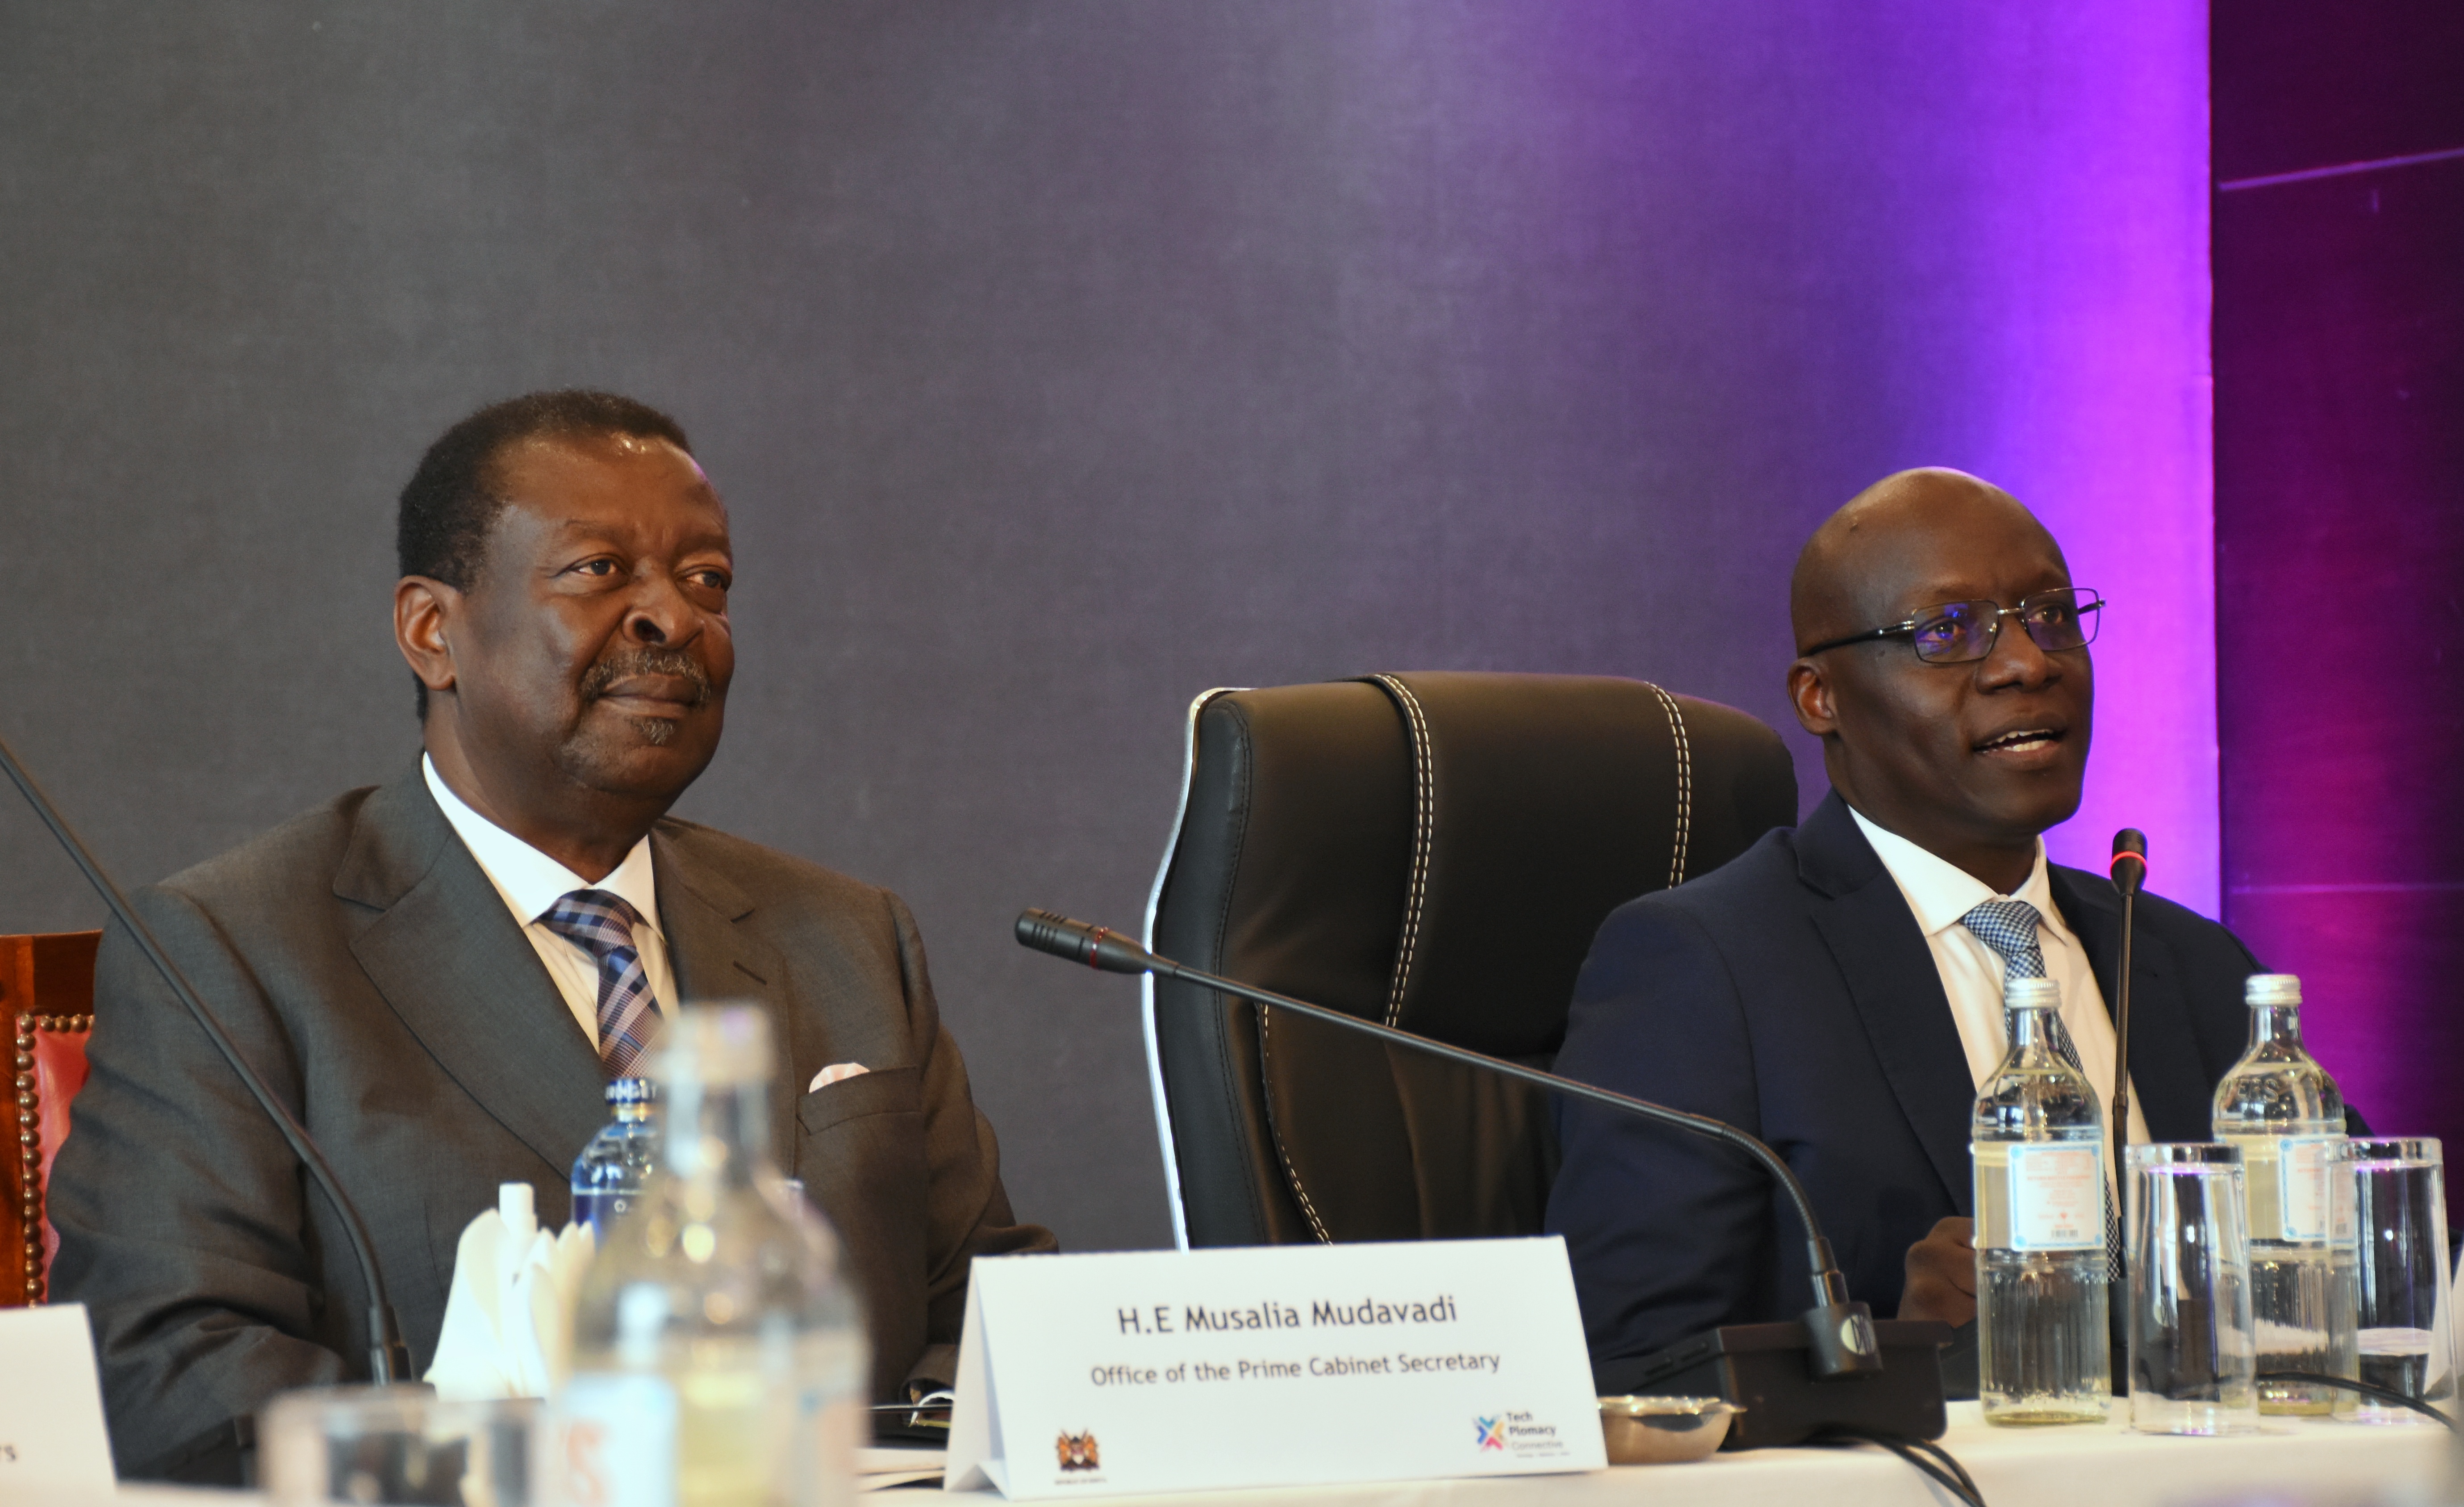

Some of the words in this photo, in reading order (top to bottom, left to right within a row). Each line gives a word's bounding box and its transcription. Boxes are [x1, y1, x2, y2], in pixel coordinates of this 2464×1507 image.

[1118, 1306, 1174, 1335] H.E
[1186, 1301, 1300, 1331] Musalia
[1312, 1294, 1457, 1327] Mudavadi
[1090, 1365, 1158, 1386] Office
[1165, 1362, 1186, 1383] of
[1194, 1362, 1231, 1381] the
[1237, 1360, 1302, 1379] Prime
[1309, 1356, 1392, 1377] Cabinet
[1397, 1353, 1500, 1374] Secretary
[1506, 1411, 1533, 1423] Tech
[1508, 1425, 1556, 1437] Plomacy
